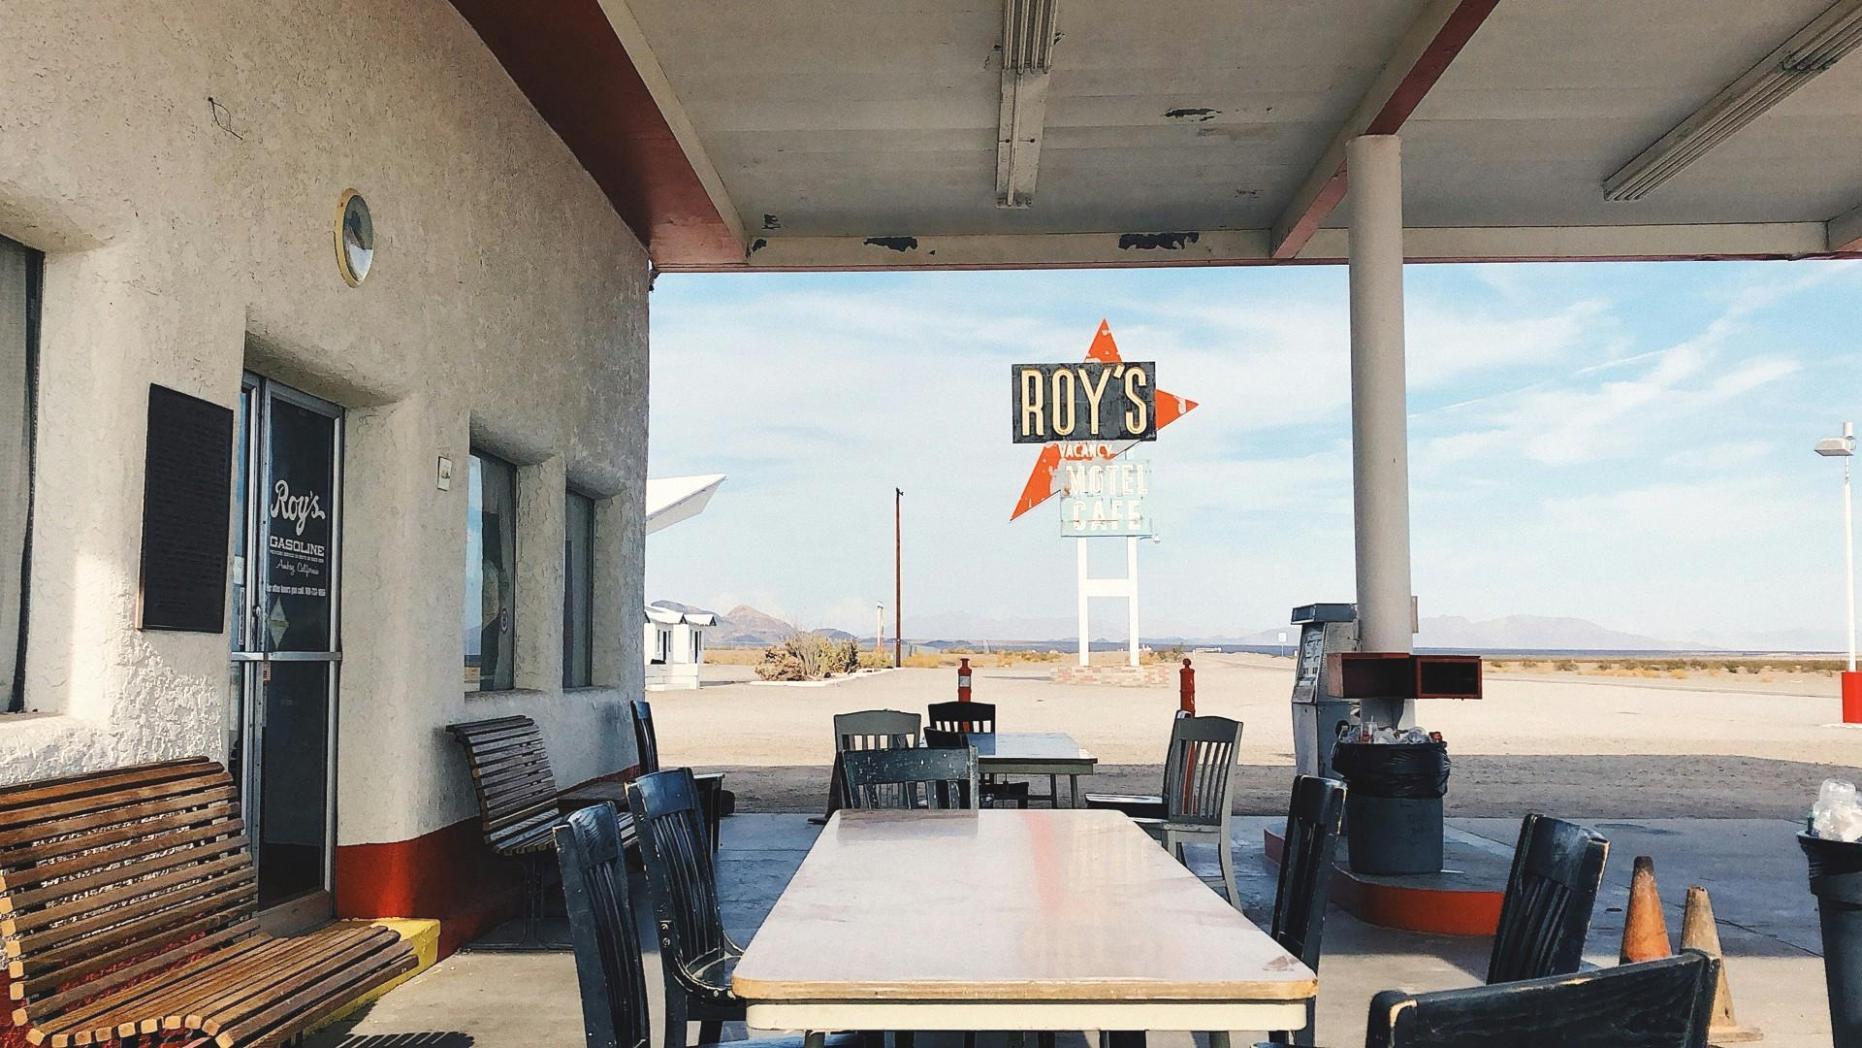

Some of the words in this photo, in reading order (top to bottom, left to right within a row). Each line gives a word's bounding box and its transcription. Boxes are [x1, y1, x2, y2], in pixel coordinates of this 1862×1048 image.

[1020, 364, 1147, 436] ROY'S
[1058, 442, 1114, 459] VACANCY
[1066, 464, 1148, 495] MOTEL
[270, 479, 326, 536] Roy's
[1073, 500, 1141, 531] CAFE
[269, 535, 325, 557] GASOLINE
